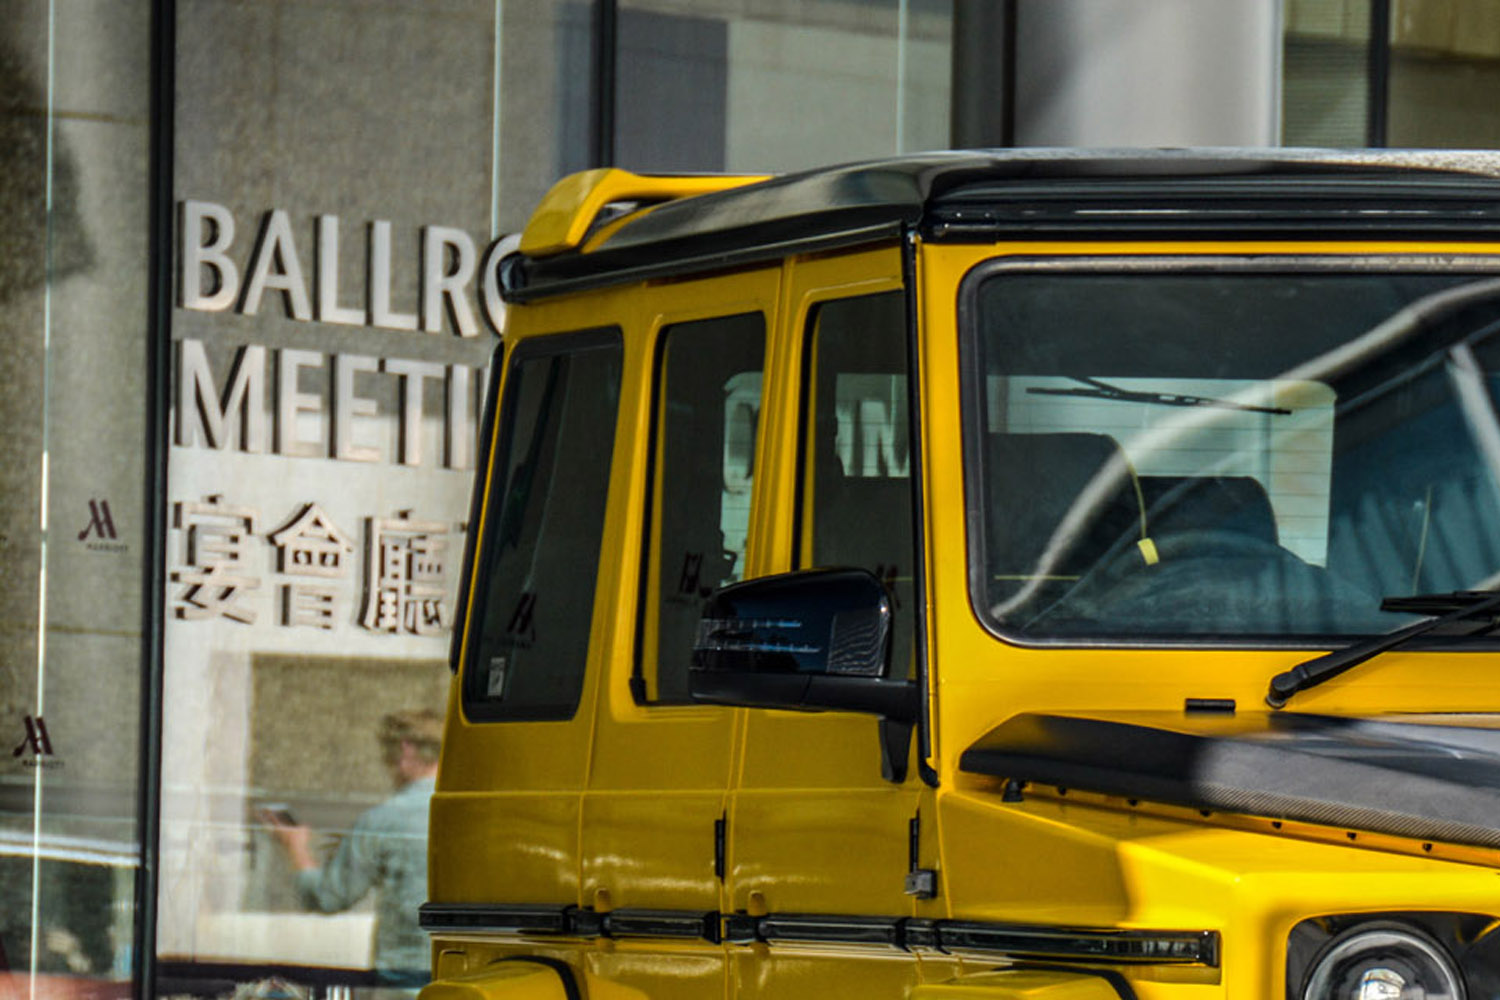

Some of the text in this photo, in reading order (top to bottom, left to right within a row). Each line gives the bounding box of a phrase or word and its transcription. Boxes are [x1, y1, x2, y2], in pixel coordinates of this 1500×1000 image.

[176, 339, 488, 470] MEETI
[171, 494, 468, 635] 宴會廳
